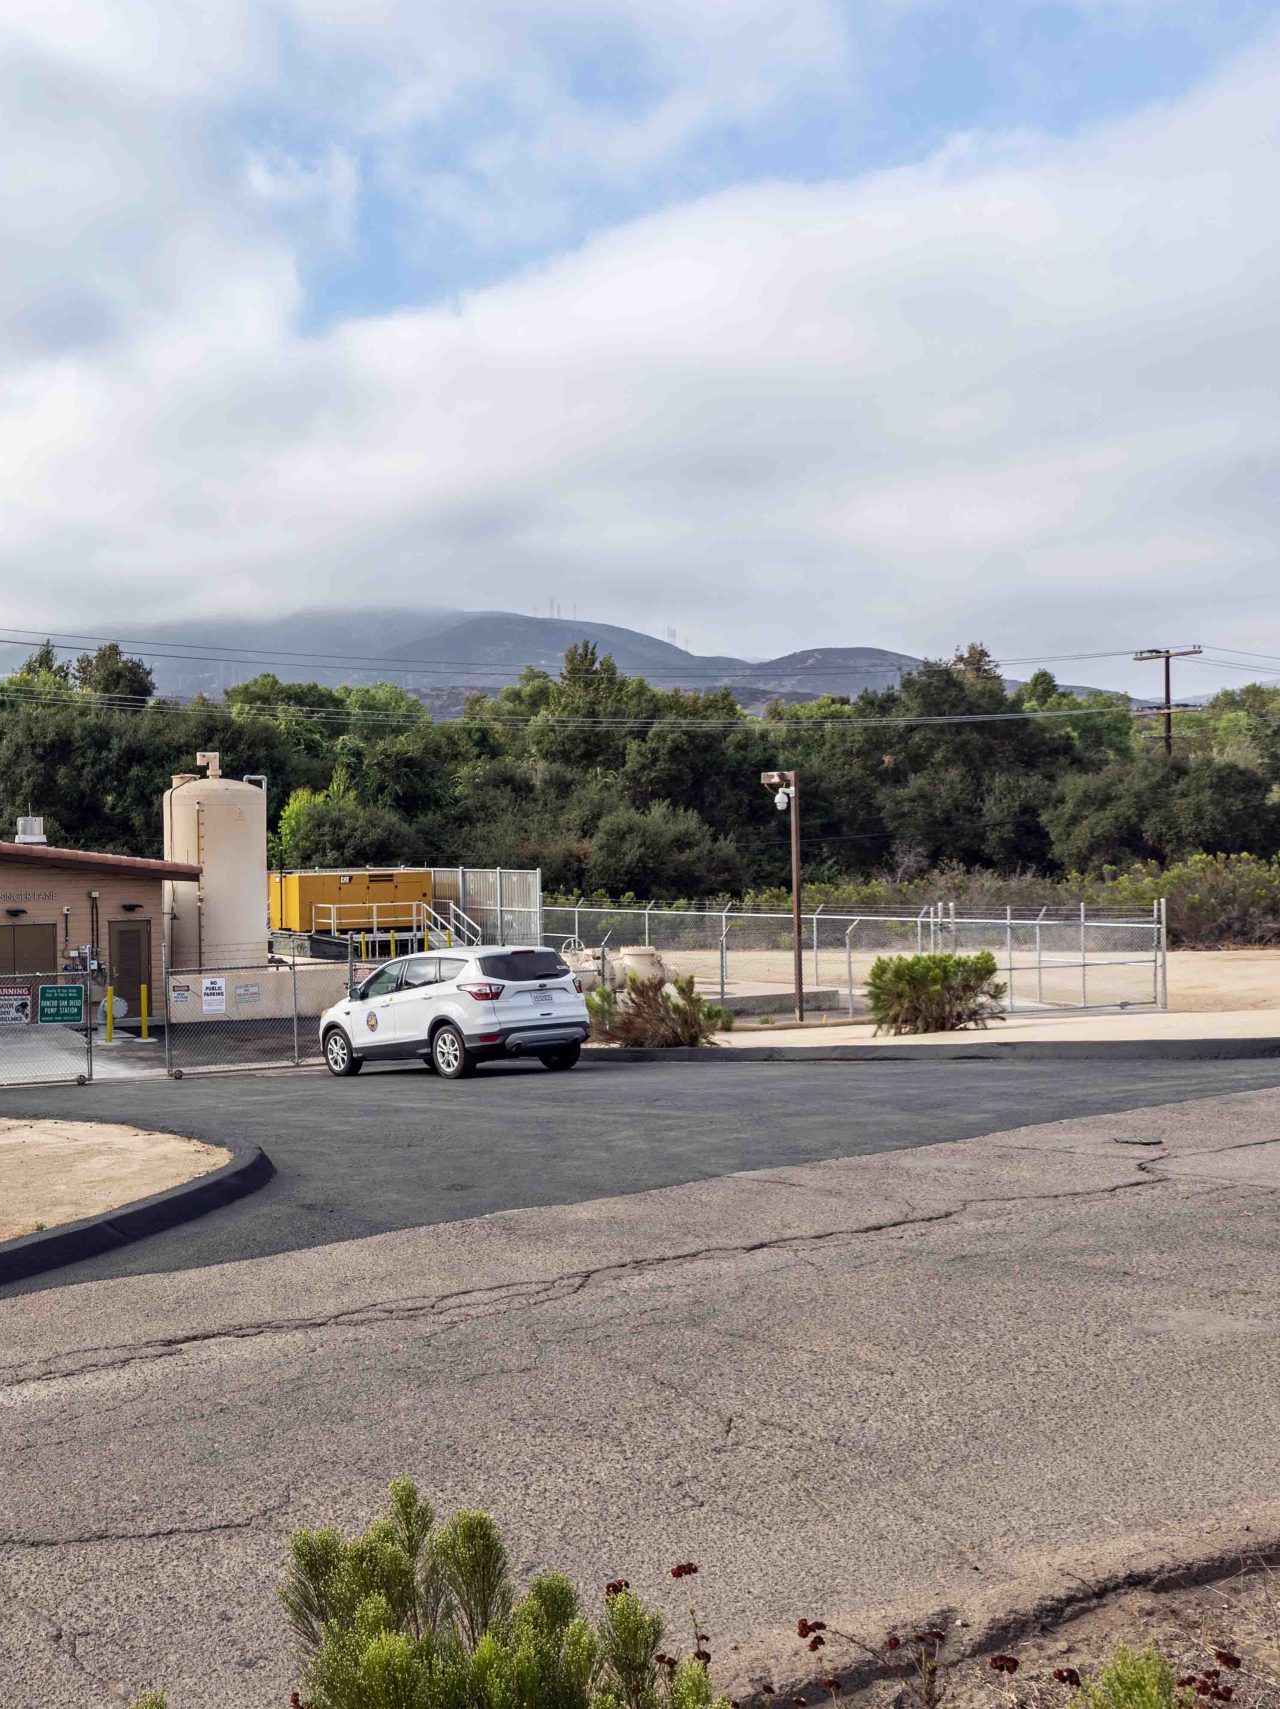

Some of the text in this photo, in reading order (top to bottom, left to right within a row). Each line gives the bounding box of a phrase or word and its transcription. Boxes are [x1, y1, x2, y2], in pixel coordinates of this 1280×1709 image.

[340, 876, 350, 884] CAT
[0, 892, 32, 902] SINGER
[34, 891, 57, 901] LANE
